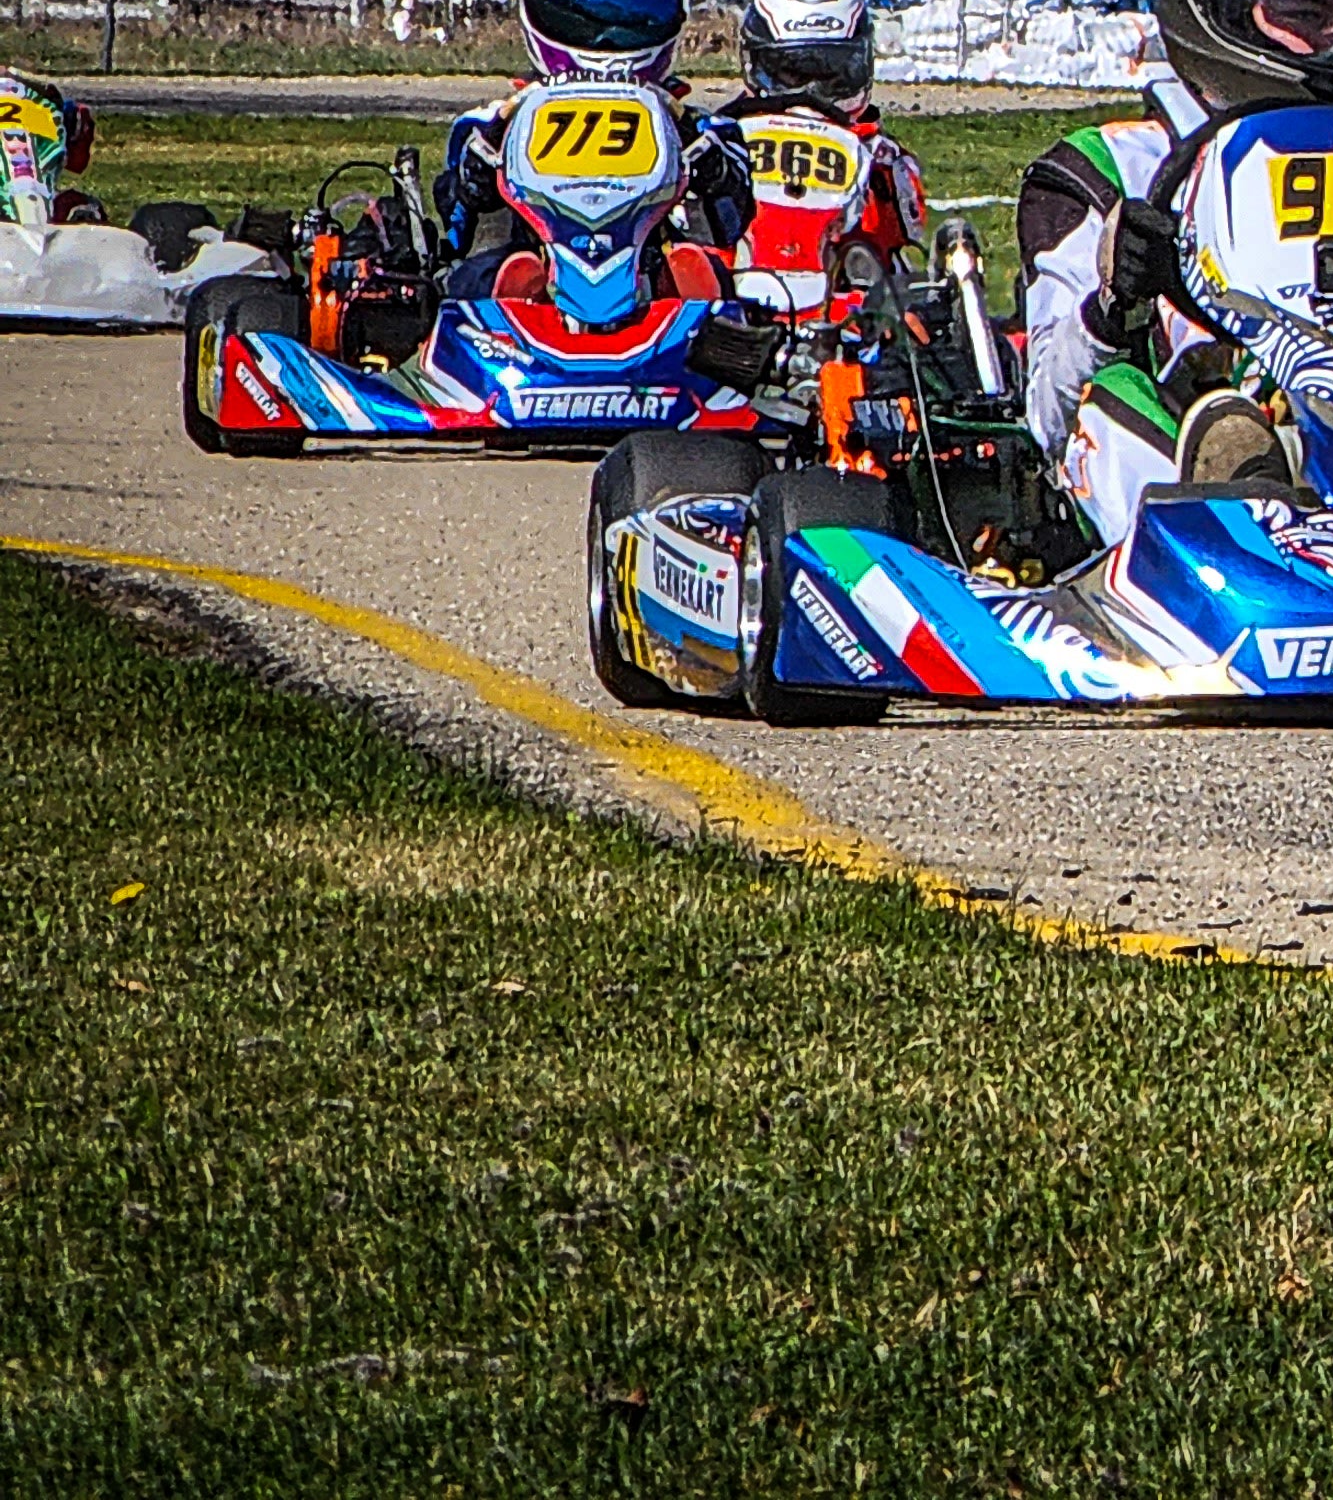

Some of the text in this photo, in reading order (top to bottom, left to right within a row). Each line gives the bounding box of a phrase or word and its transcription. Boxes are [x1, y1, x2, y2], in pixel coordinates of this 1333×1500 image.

[535, 109, 641, 161] 713
[745, 138, 848, 187] 369
[514, 387, 680, 421] VEMMEKART
[790, 568, 878, 681] VEMMEKART
